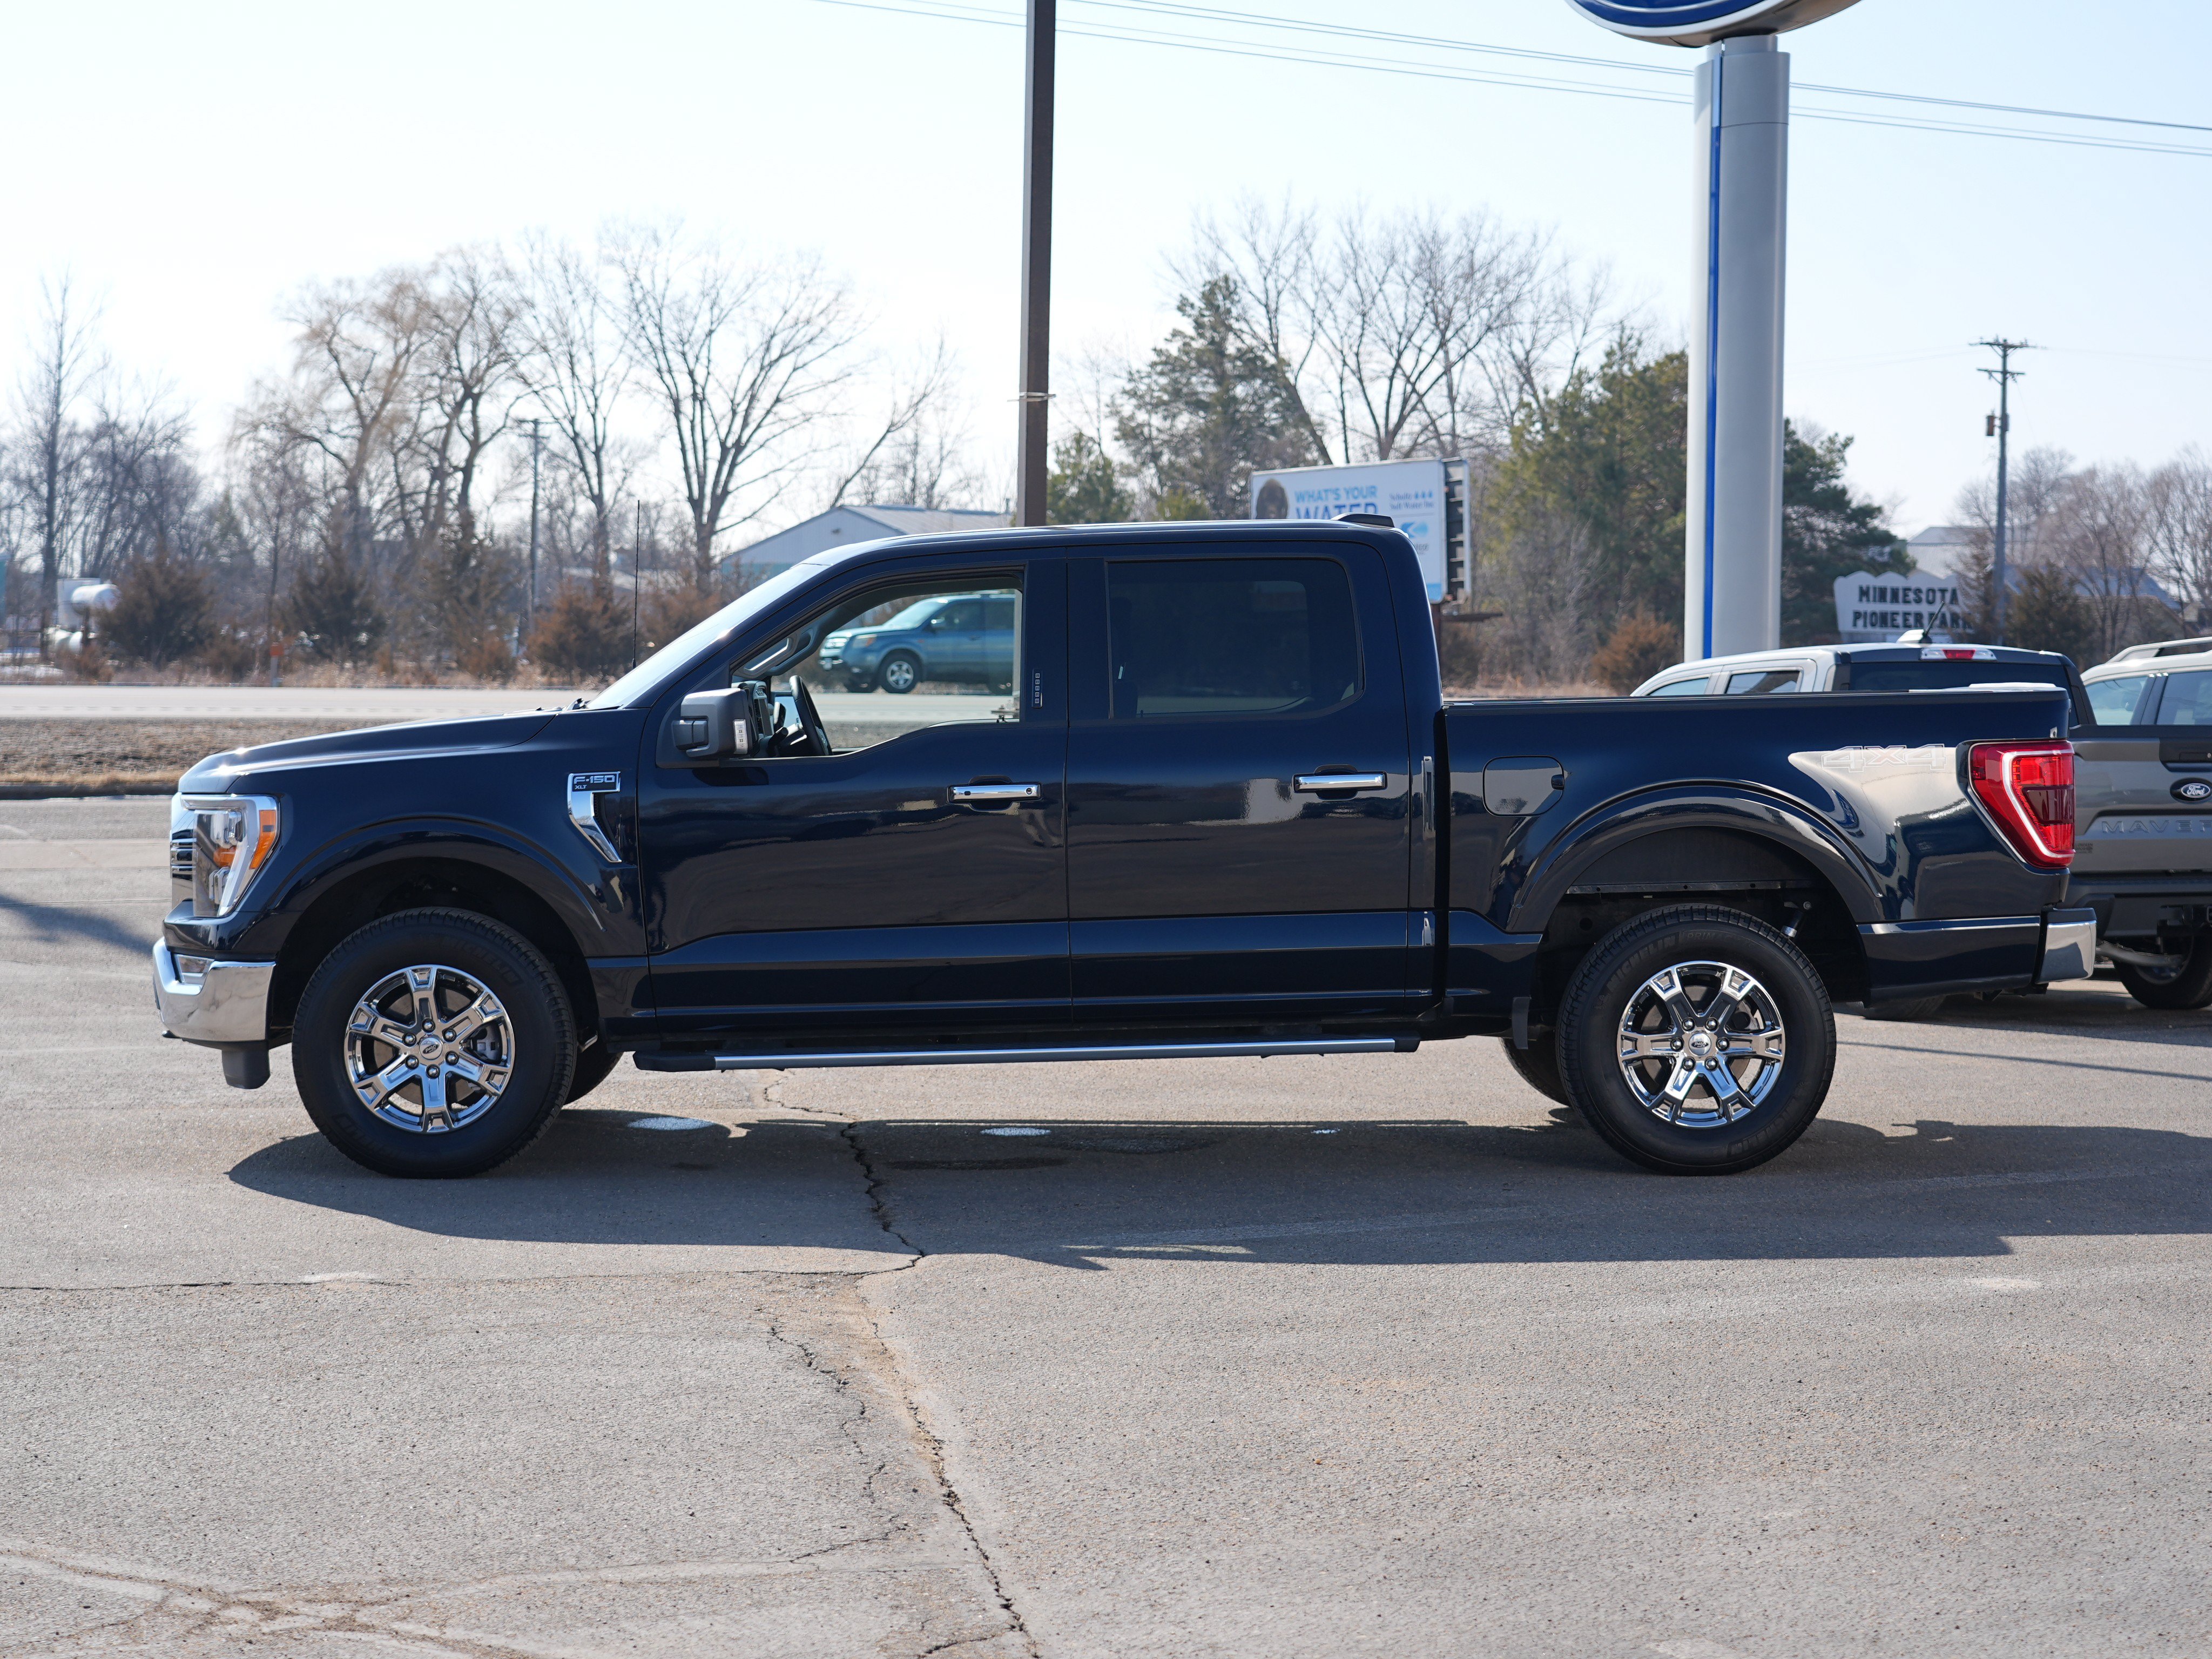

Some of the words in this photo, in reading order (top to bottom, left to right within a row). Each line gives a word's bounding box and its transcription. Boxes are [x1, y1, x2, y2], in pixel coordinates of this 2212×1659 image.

[1294, 488, 1341, 503] WHAT'S
[1344, 485, 1378, 500] YOUR
[1858, 585, 1959, 604] MINNESOTA
[1852, 610, 1924, 628] PIONEER
[574, 774, 616, 784] F-150
[2187, 785, 2206, 796] Ford
